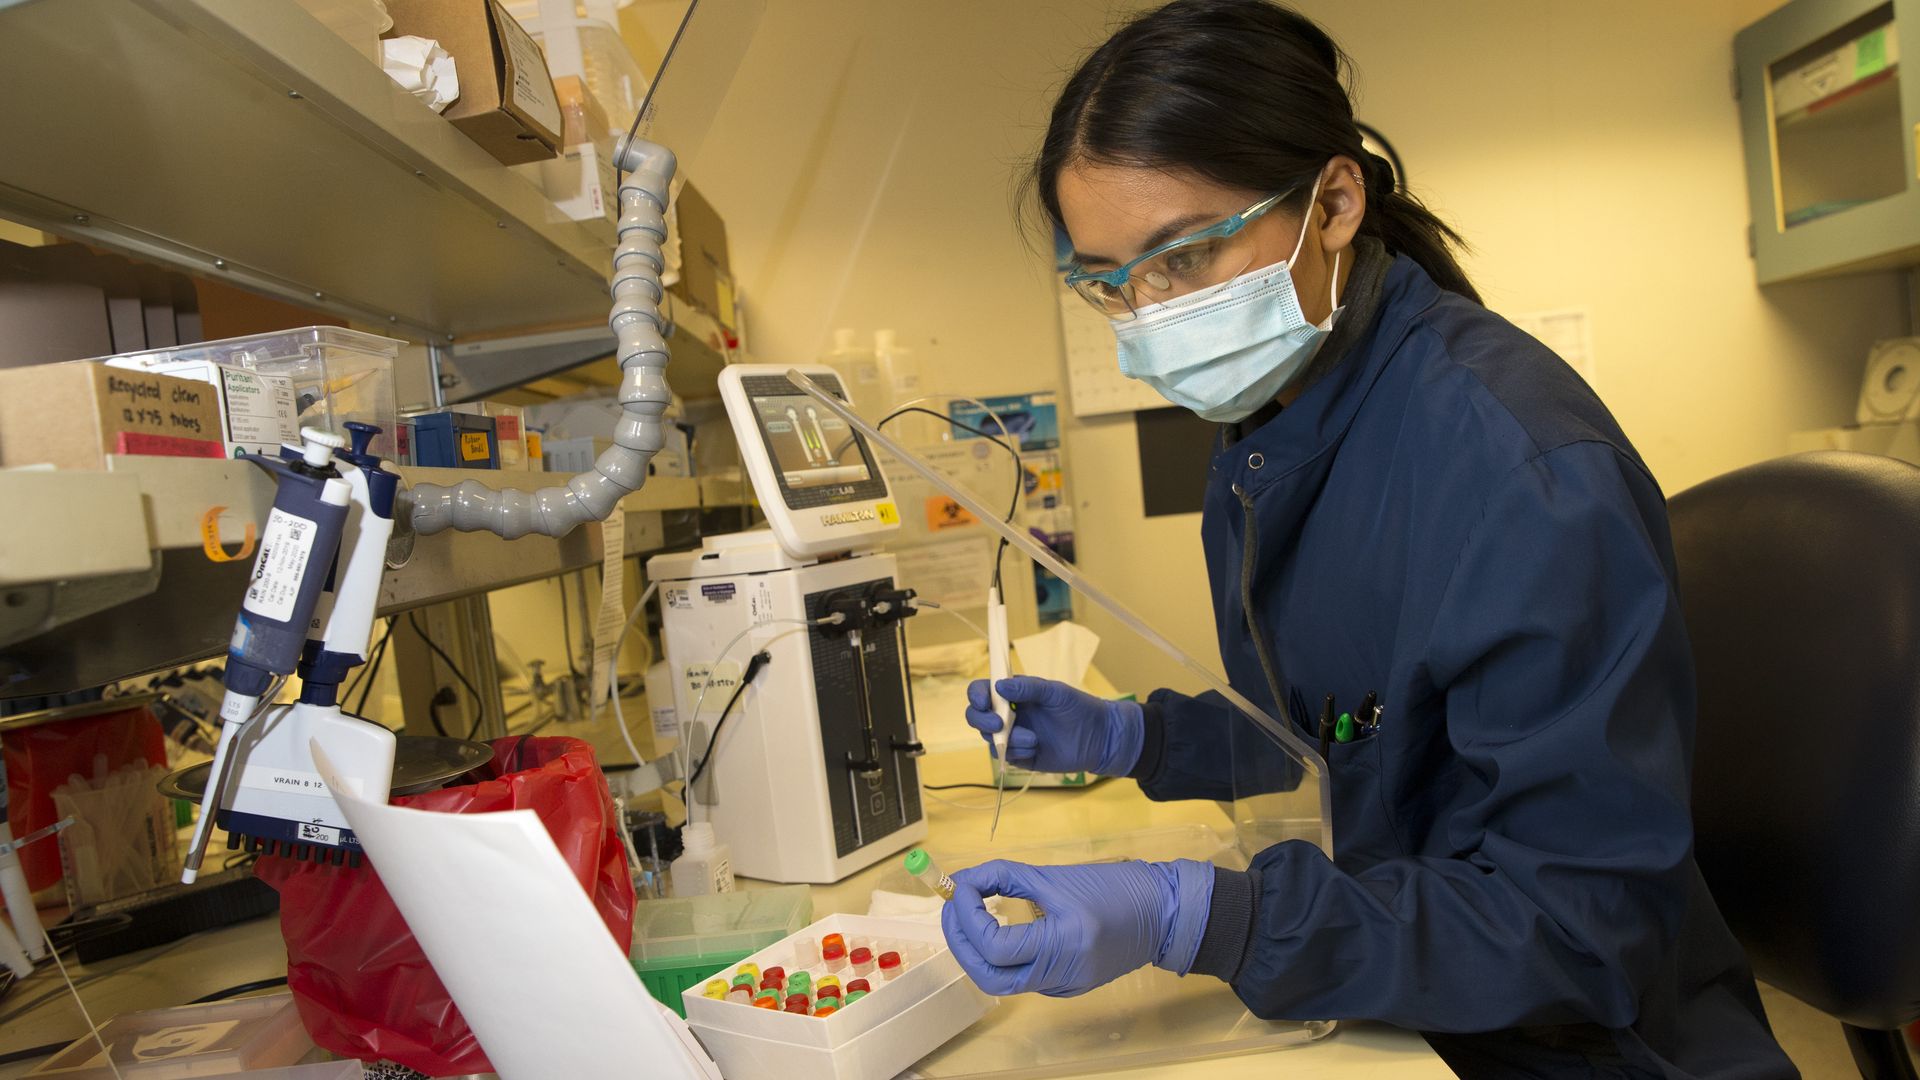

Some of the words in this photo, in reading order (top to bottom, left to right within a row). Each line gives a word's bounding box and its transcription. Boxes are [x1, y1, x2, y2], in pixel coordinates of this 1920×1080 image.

[225, 371, 253, 383] Puritan
[107, 375, 161, 402] Recycled
[172, 385, 201, 405] clean
[228, 384, 261, 394] Applicators
[170, 412, 201, 433] tubes
[820, 509, 875, 527] HAMILTON
[273, 776, 300, 787] VRAIN
[304, 780, 310, 788] 8
